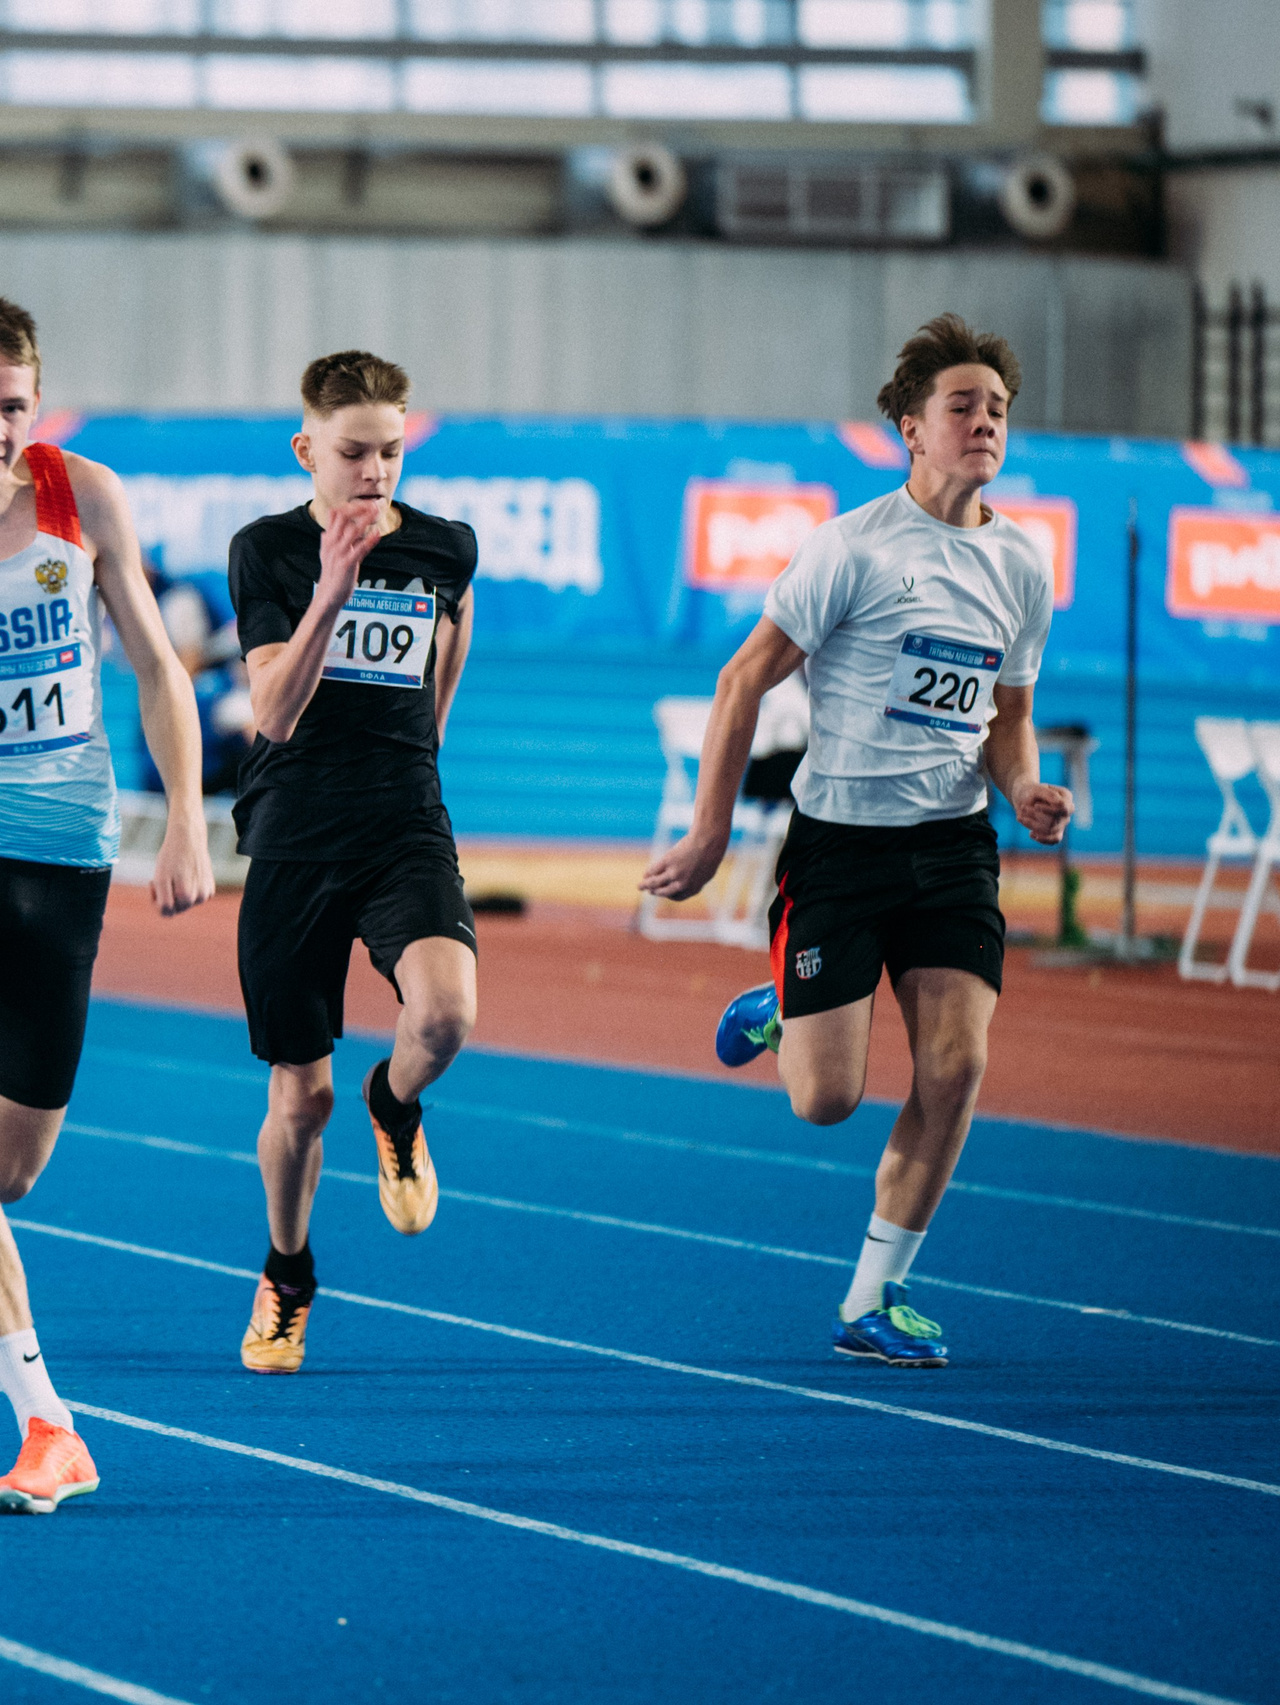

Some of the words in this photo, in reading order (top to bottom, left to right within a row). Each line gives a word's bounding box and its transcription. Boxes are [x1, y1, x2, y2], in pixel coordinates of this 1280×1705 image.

[376, 599, 412, 613] ЛЕБЕДЕВОЙ
[335, 619, 414, 664] 109
[360, 671, 385, 681] ВФЛА
[908, 667, 980, 714] 220
[929, 718, 951, 729] ВФЛА
